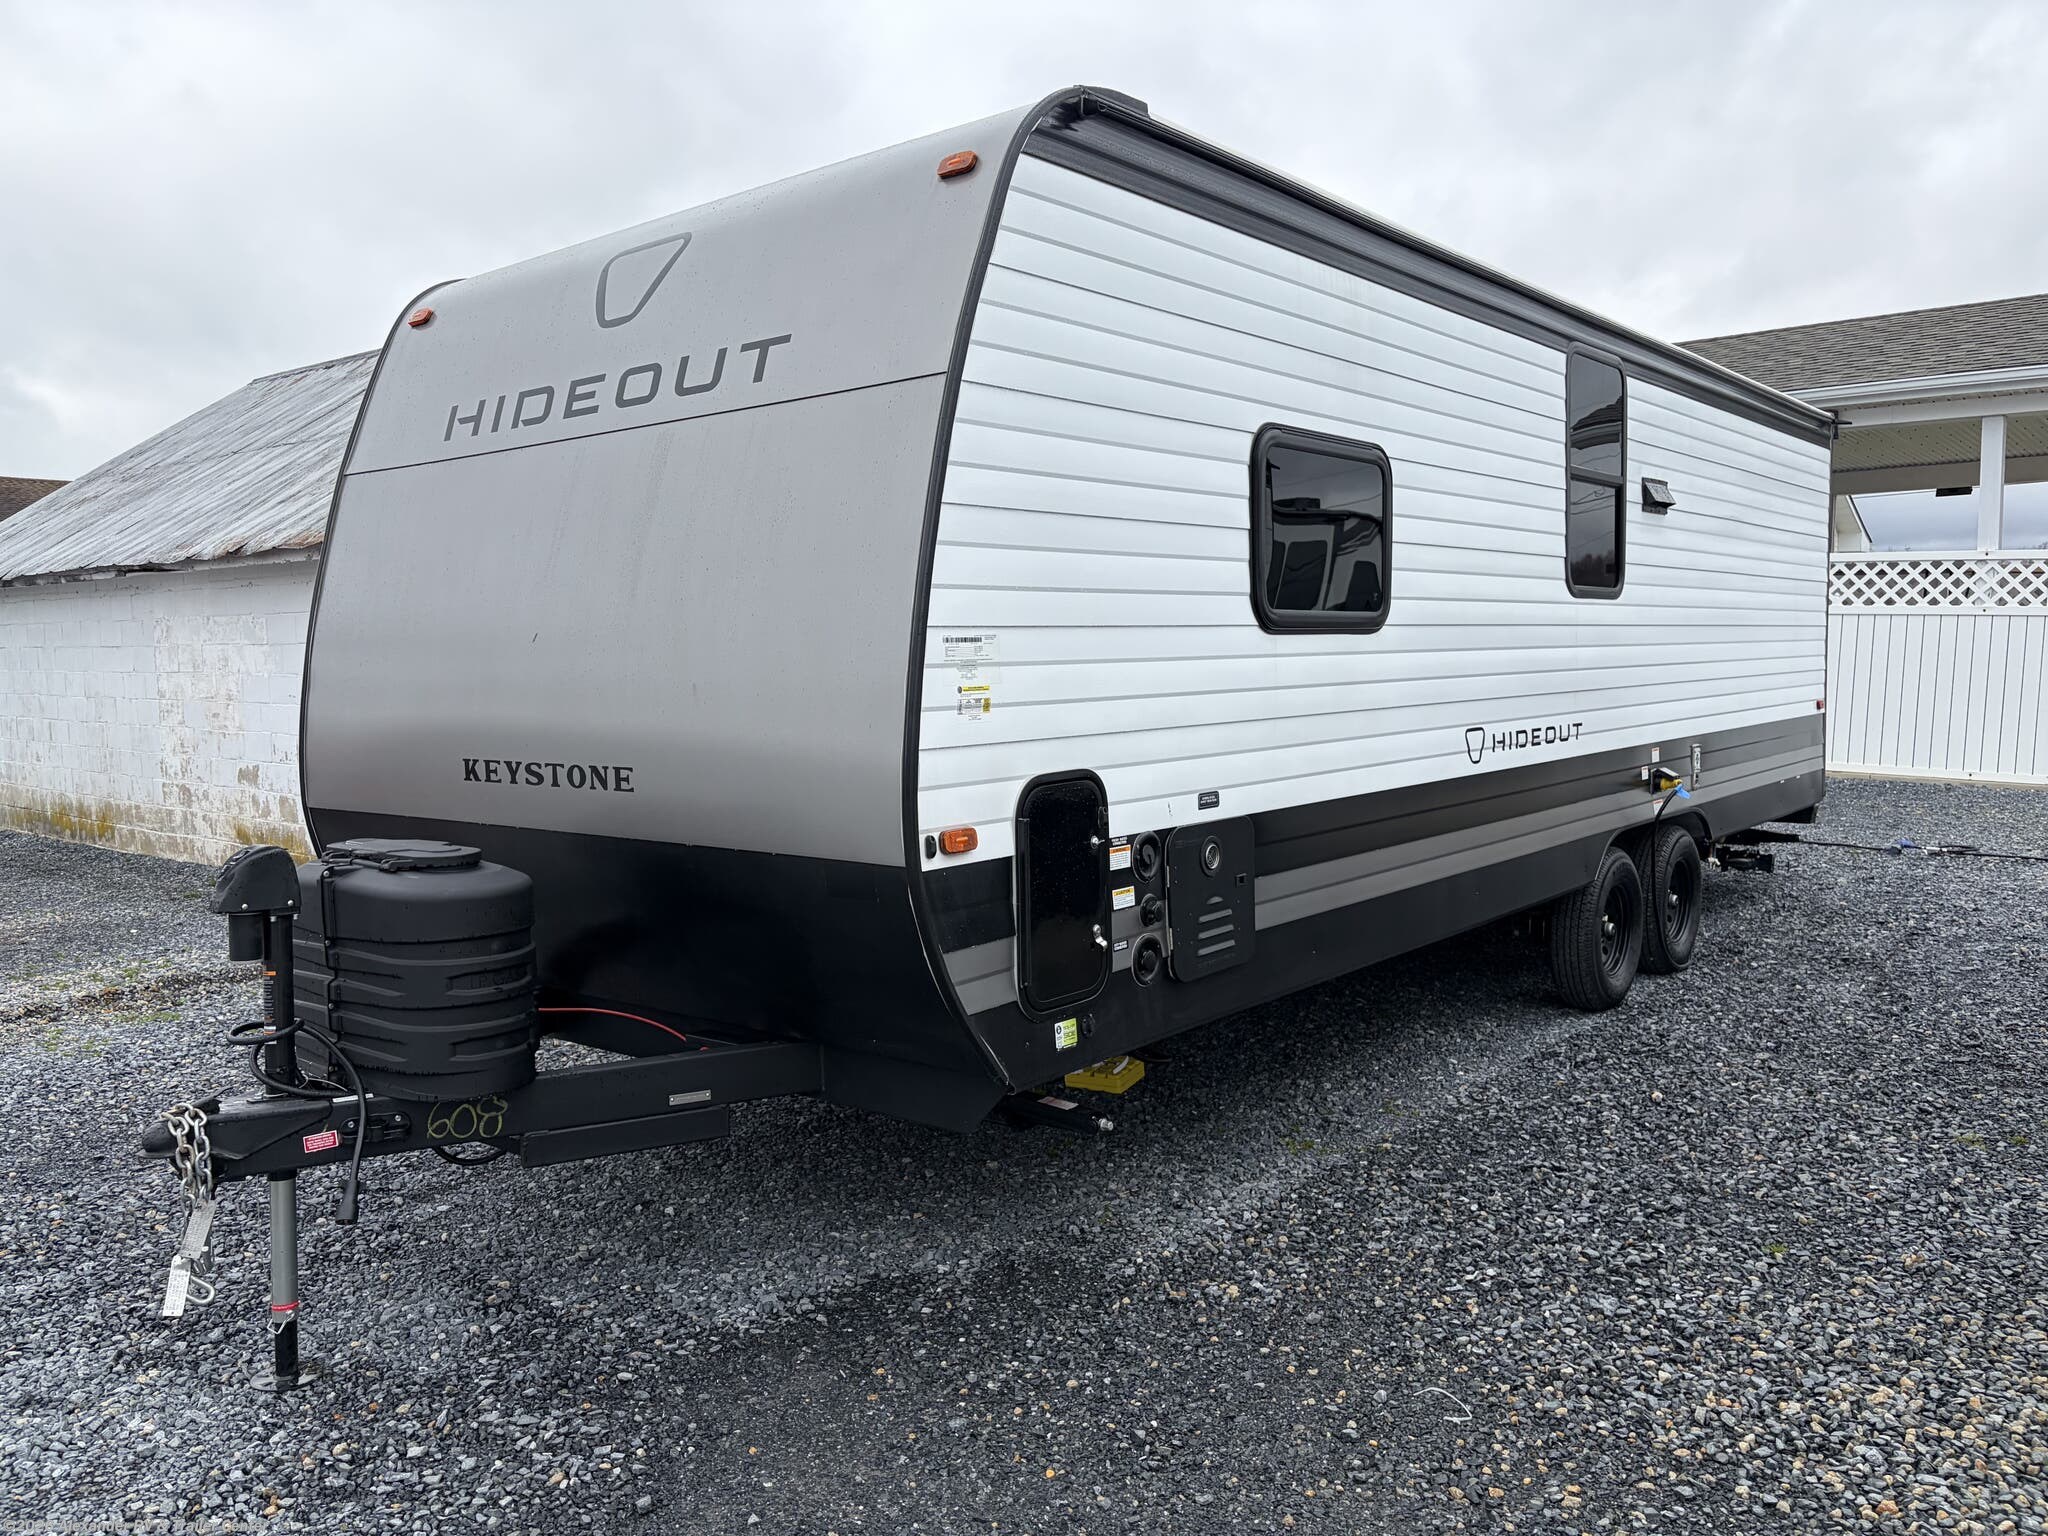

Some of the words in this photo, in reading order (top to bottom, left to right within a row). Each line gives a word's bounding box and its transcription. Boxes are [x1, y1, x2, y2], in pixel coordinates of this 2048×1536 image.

[444, 333, 792, 442] HIDEOUT
[1492, 722, 1583, 752] HIDEOUT
[462, 758, 635, 792] KEYSTONE
[427, 1096, 508, 1138] 608
